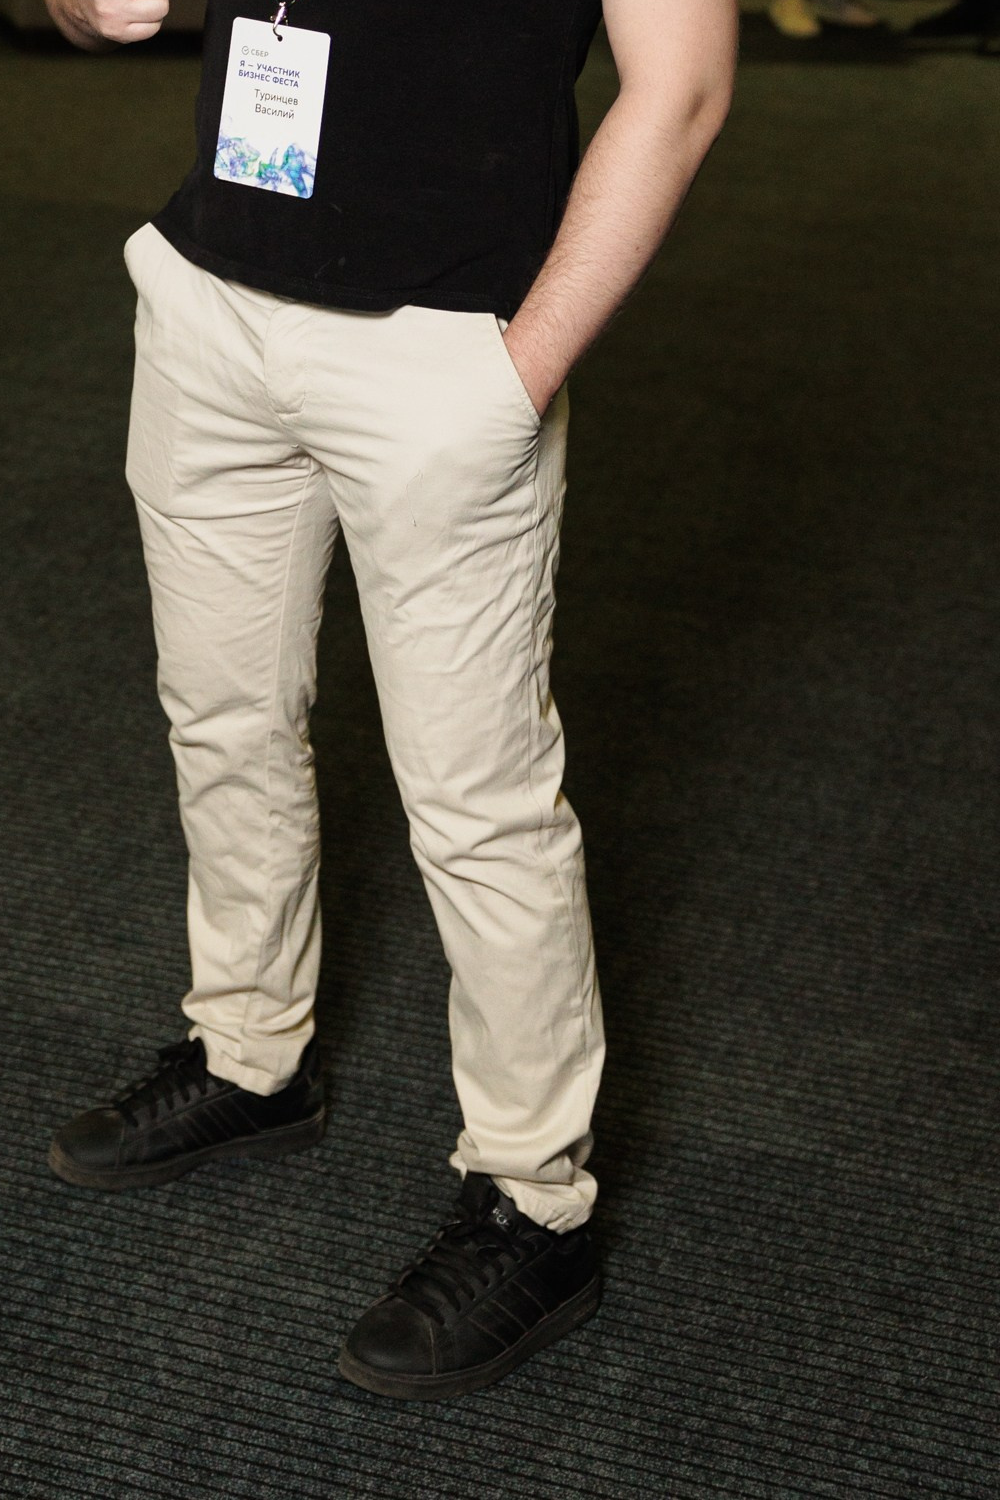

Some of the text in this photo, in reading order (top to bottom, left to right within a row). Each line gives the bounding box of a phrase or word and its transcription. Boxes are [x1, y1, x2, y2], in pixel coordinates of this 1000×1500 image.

[251, 48, 269, 57] СБЕР
[238, 69, 299, 88] БИЗНЕС ФЕСТА
[256, 63, 300, 78] УЧАСТНИК
[254, 88, 299, 106] Туринцев
[254, 103, 295, 119] Василий
